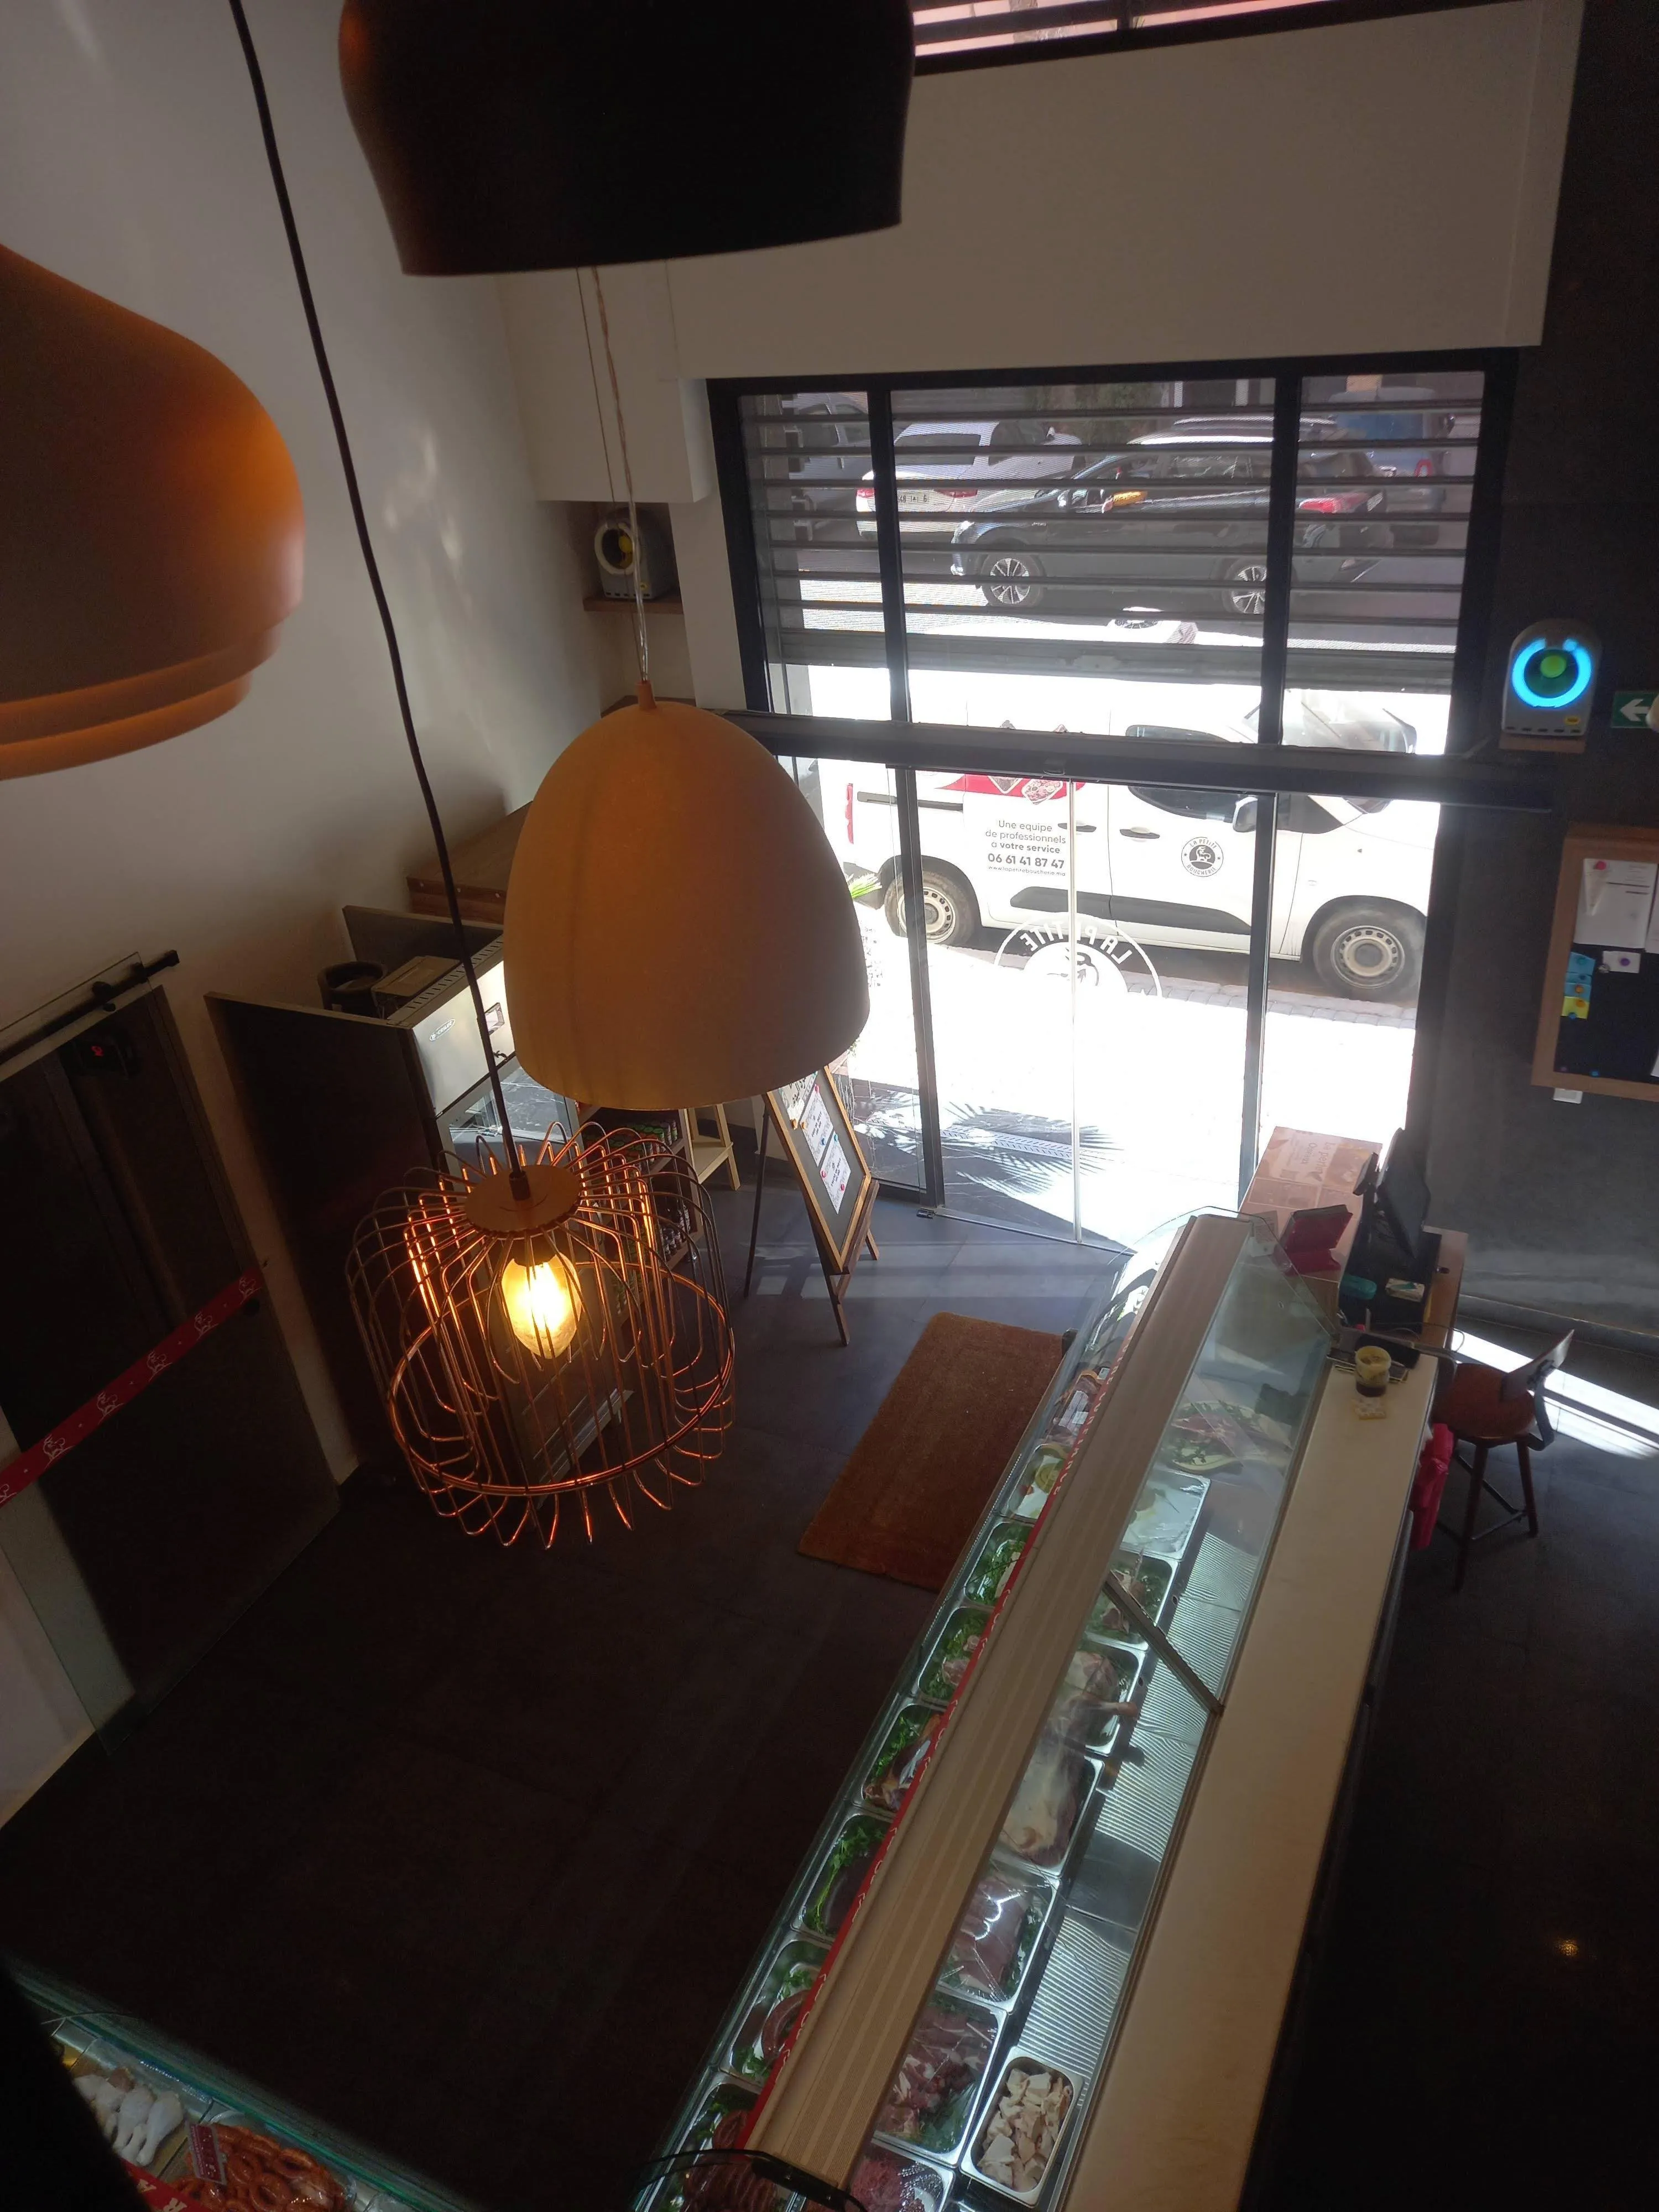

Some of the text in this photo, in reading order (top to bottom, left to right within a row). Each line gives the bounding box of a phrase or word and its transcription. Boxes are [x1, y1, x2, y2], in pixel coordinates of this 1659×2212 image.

[999, 820, 1052, 832] Une equipe
[1000, 832, 1066, 844] professionnels
[1199, 839, 1217, 848] PETITE
[1026, 845, 1060, 853] service
[988, 853, 1065, 869] 06 61 41 87 47
[1187, 864, 1217, 875] BOUCHERIE
